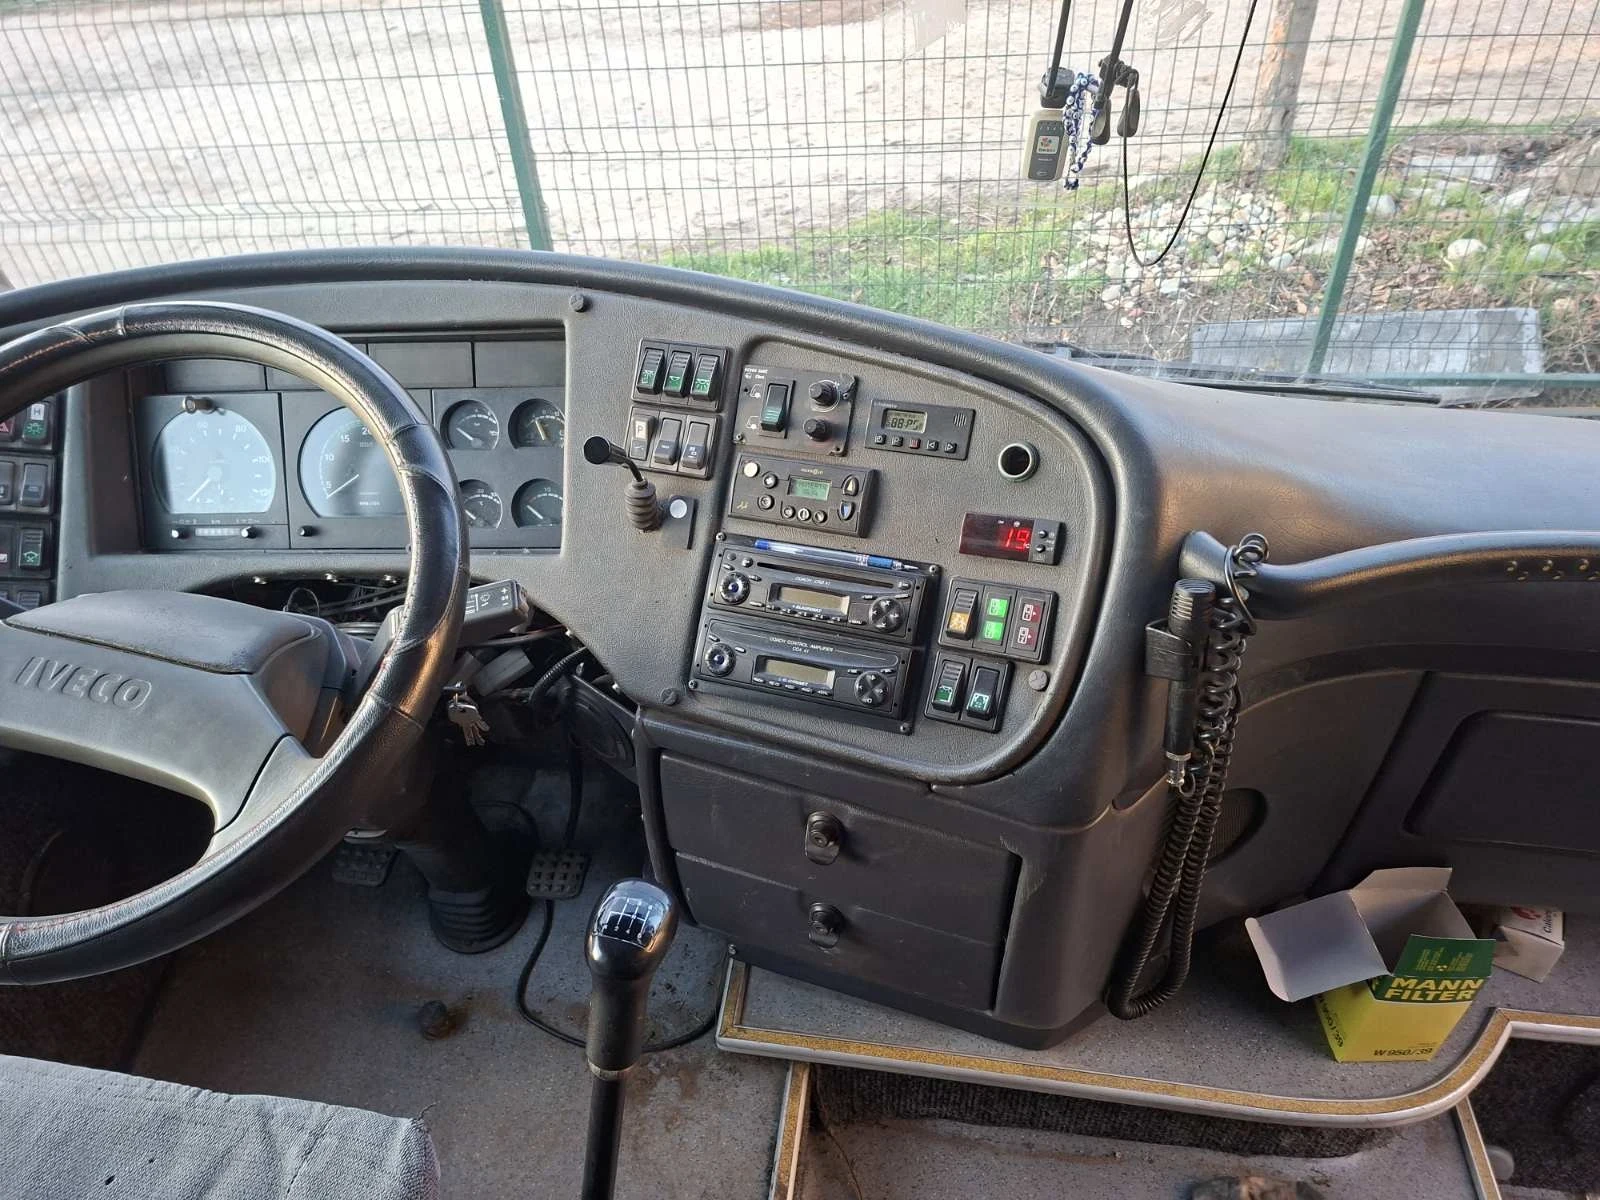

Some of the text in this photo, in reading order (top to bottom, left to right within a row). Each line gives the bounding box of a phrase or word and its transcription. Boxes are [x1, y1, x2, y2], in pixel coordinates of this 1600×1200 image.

[1004, 528, 1031, 552] 19
[15, 655, 152, 711] IVECO
[1391, 977, 1485, 991] MANN
[1384, 988, 1477, 1001] FILTER
